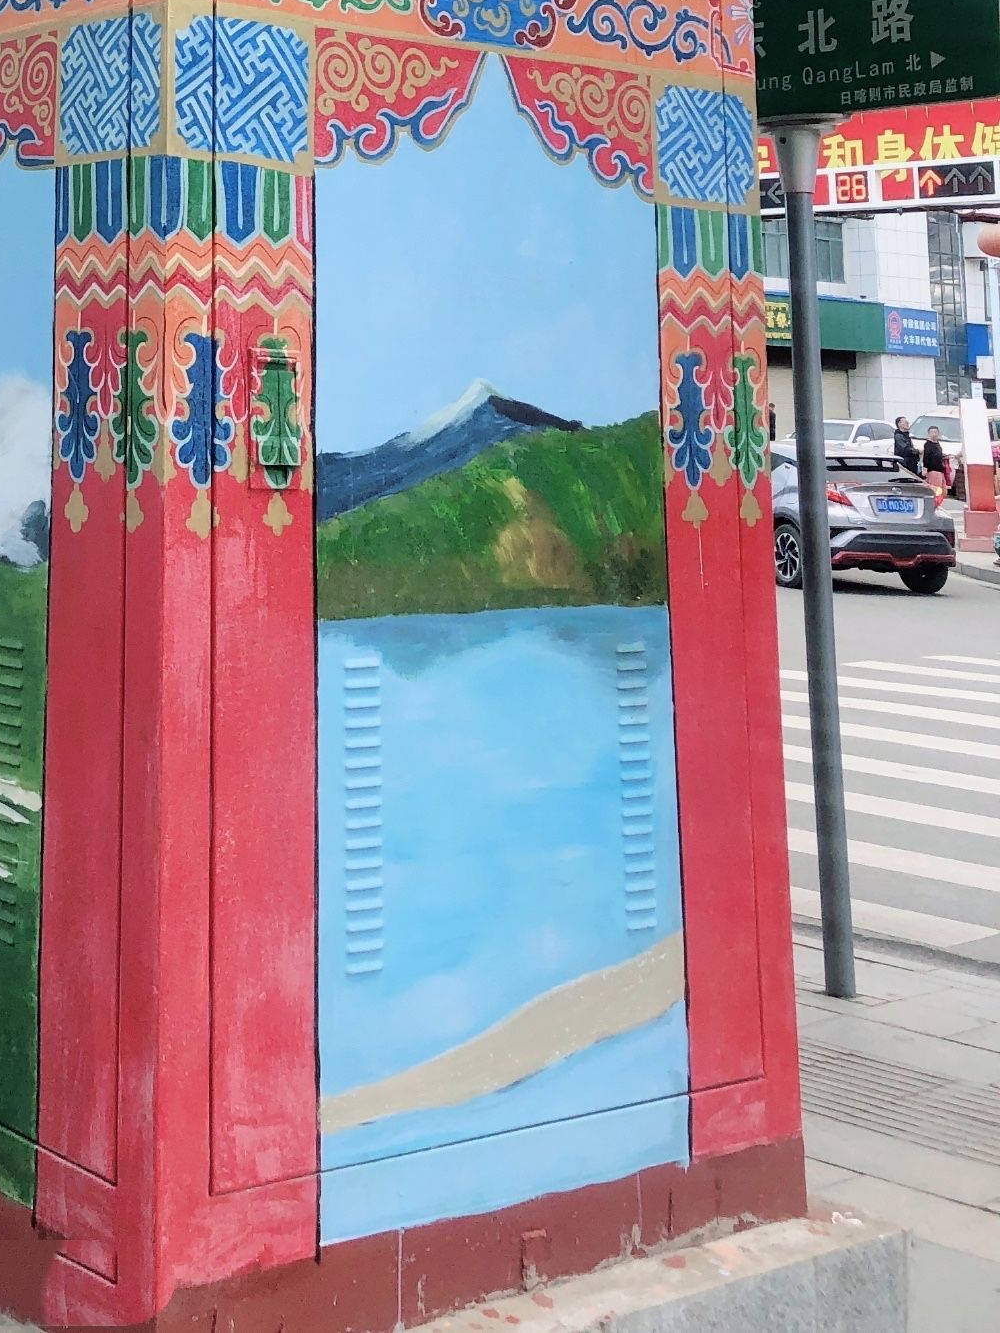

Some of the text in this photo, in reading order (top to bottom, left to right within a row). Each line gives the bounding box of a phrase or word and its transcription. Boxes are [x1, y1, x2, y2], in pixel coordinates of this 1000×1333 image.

[905, 52, 922, 72] 北
[840, 75, 974, 106] 日喀则市民政局监制
